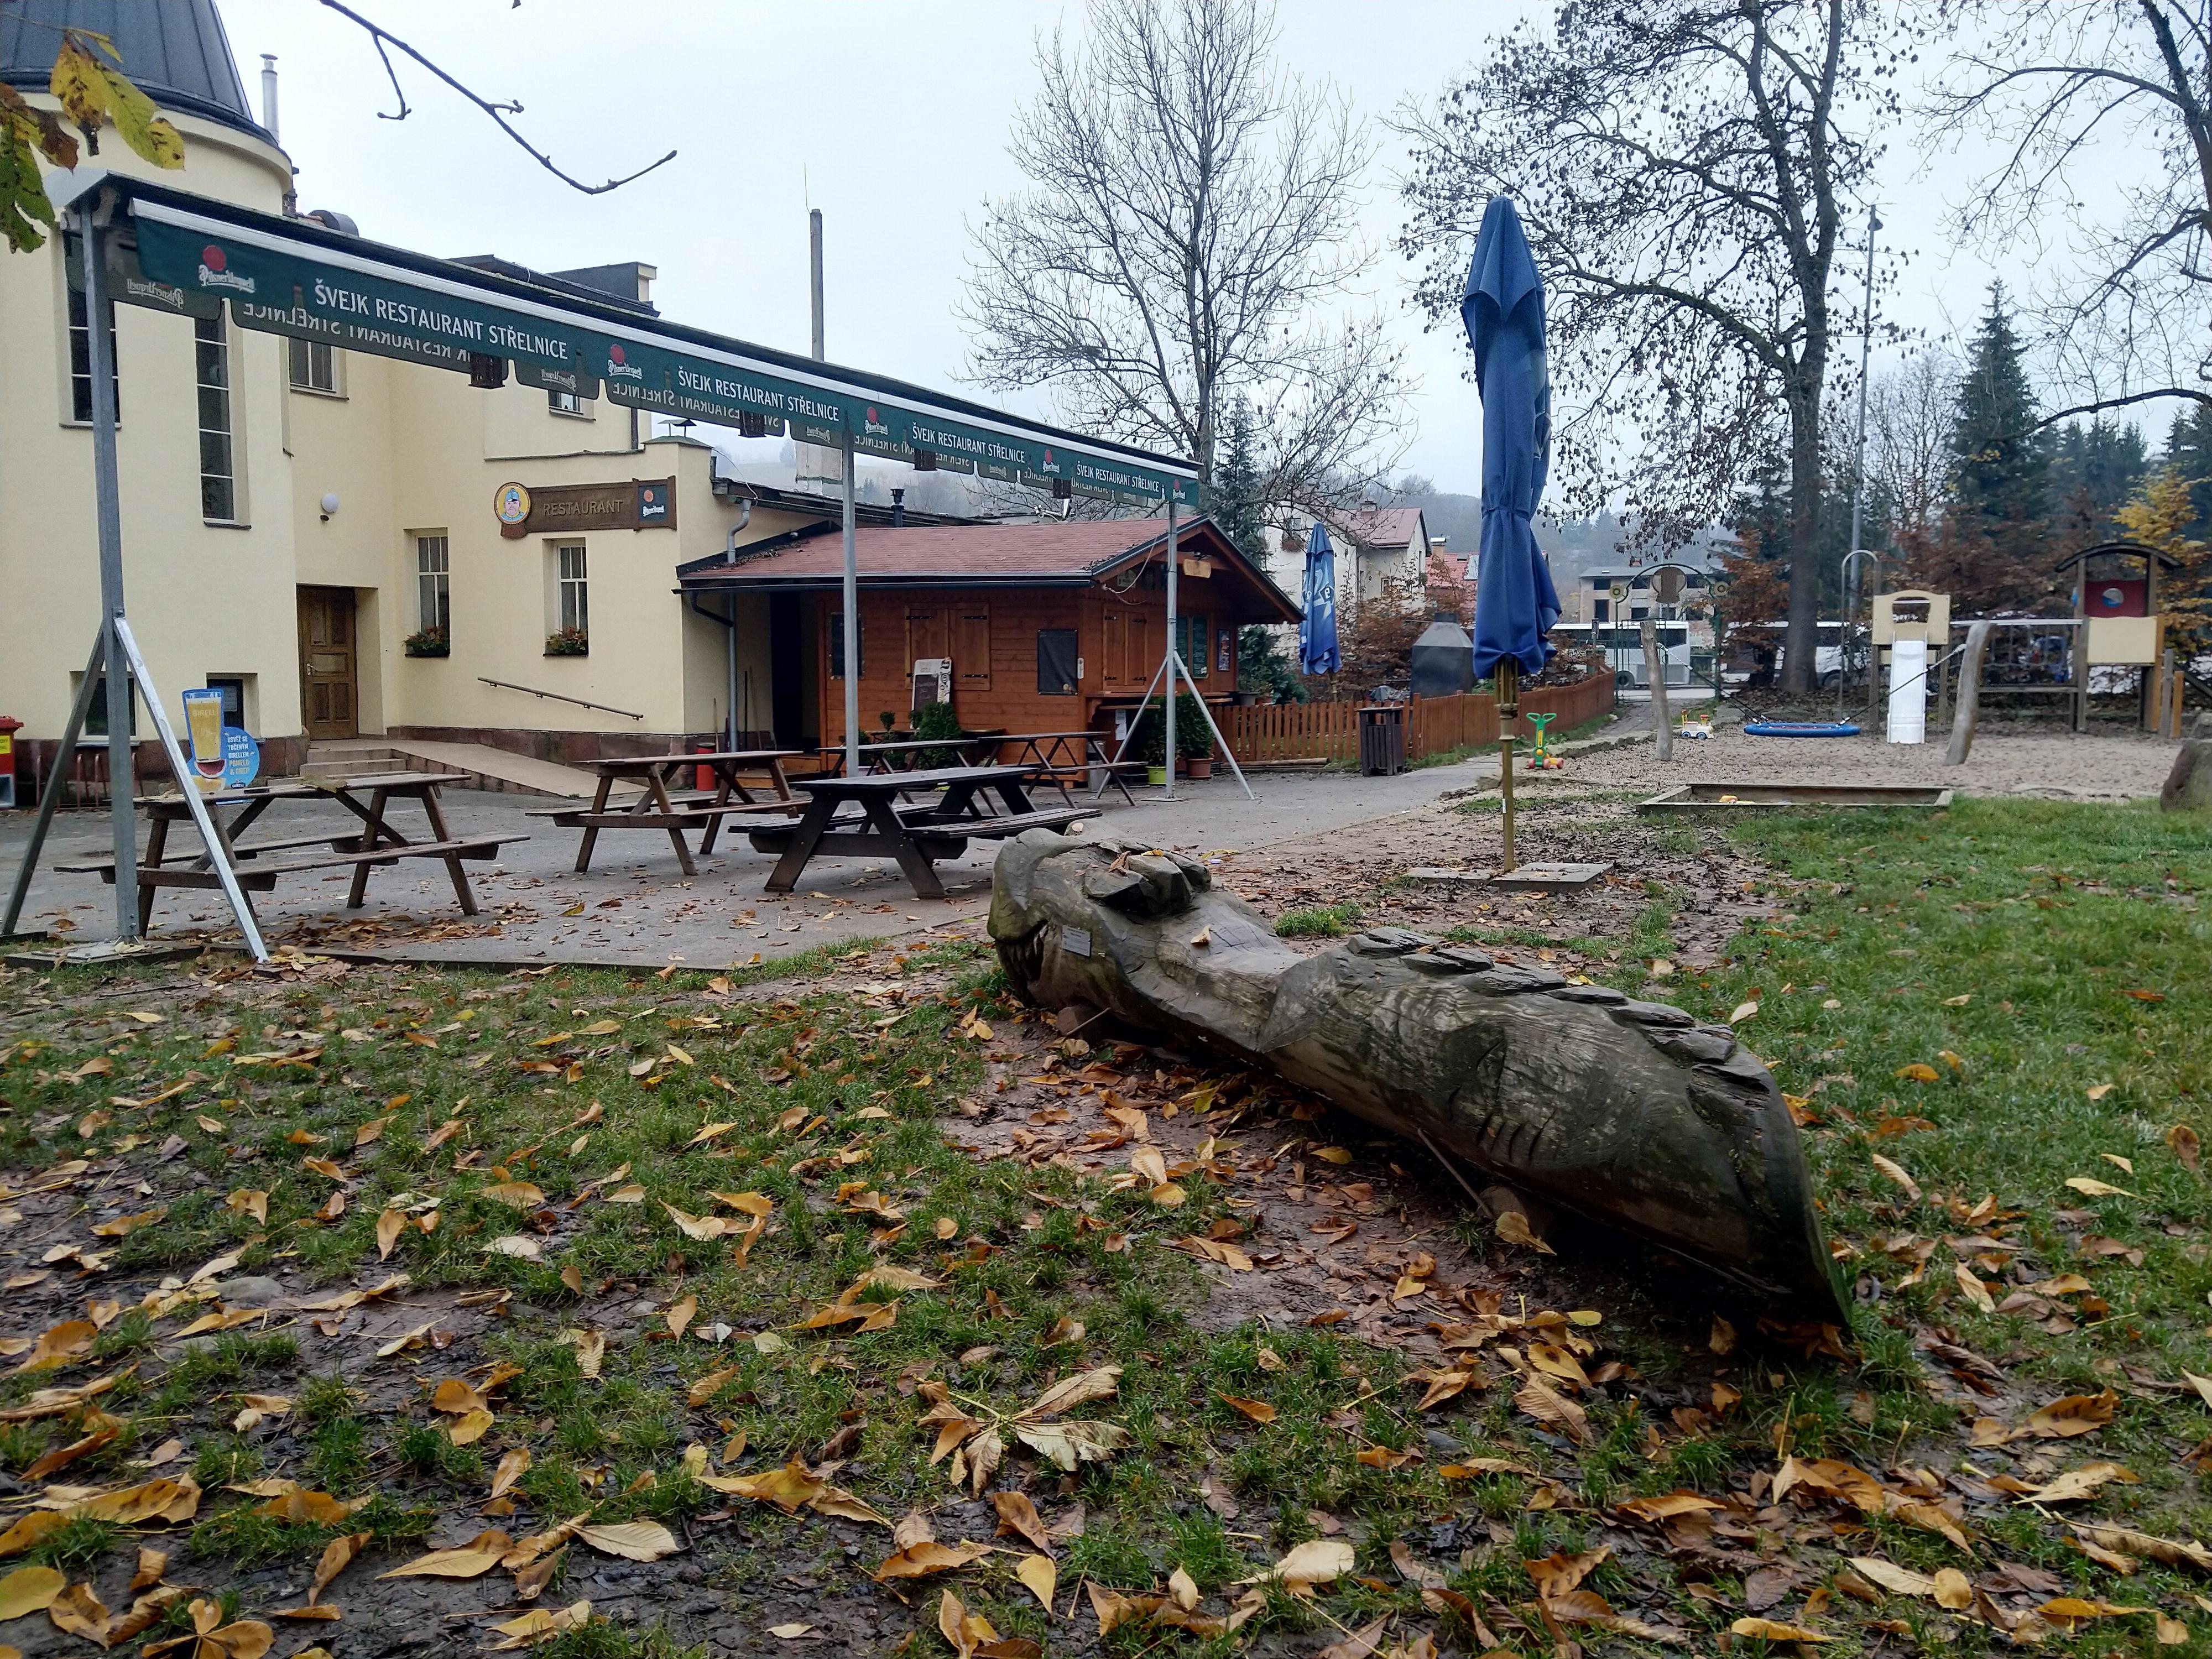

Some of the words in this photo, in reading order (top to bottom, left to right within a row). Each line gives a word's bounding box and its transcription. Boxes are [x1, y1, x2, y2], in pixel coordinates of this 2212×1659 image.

[314, 278, 369, 315] ŠVEJK
[375, 298, 483, 340] RESTAURANT
[489, 325, 568, 359] STŘELNICE
[678, 366, 712, 393] ŠVEJK
[716, 379, 784, 409] RESTAURANT
[787, 395, 839, 422] STŘELNICE
[912, 422, 936, 445] ŠVEJK
[938, 432, 987, 455] RESTAURANT
[988, 443, 1025, 463] STŘELNICE
[1077, 461, 1094, 479] ŠVEJK
[1095, 469, 1131, 486] RESTAURANT
[1132, 475, 1160, 493] STŘELNICE
[544, 500, 624, 517] RESTAURANT
